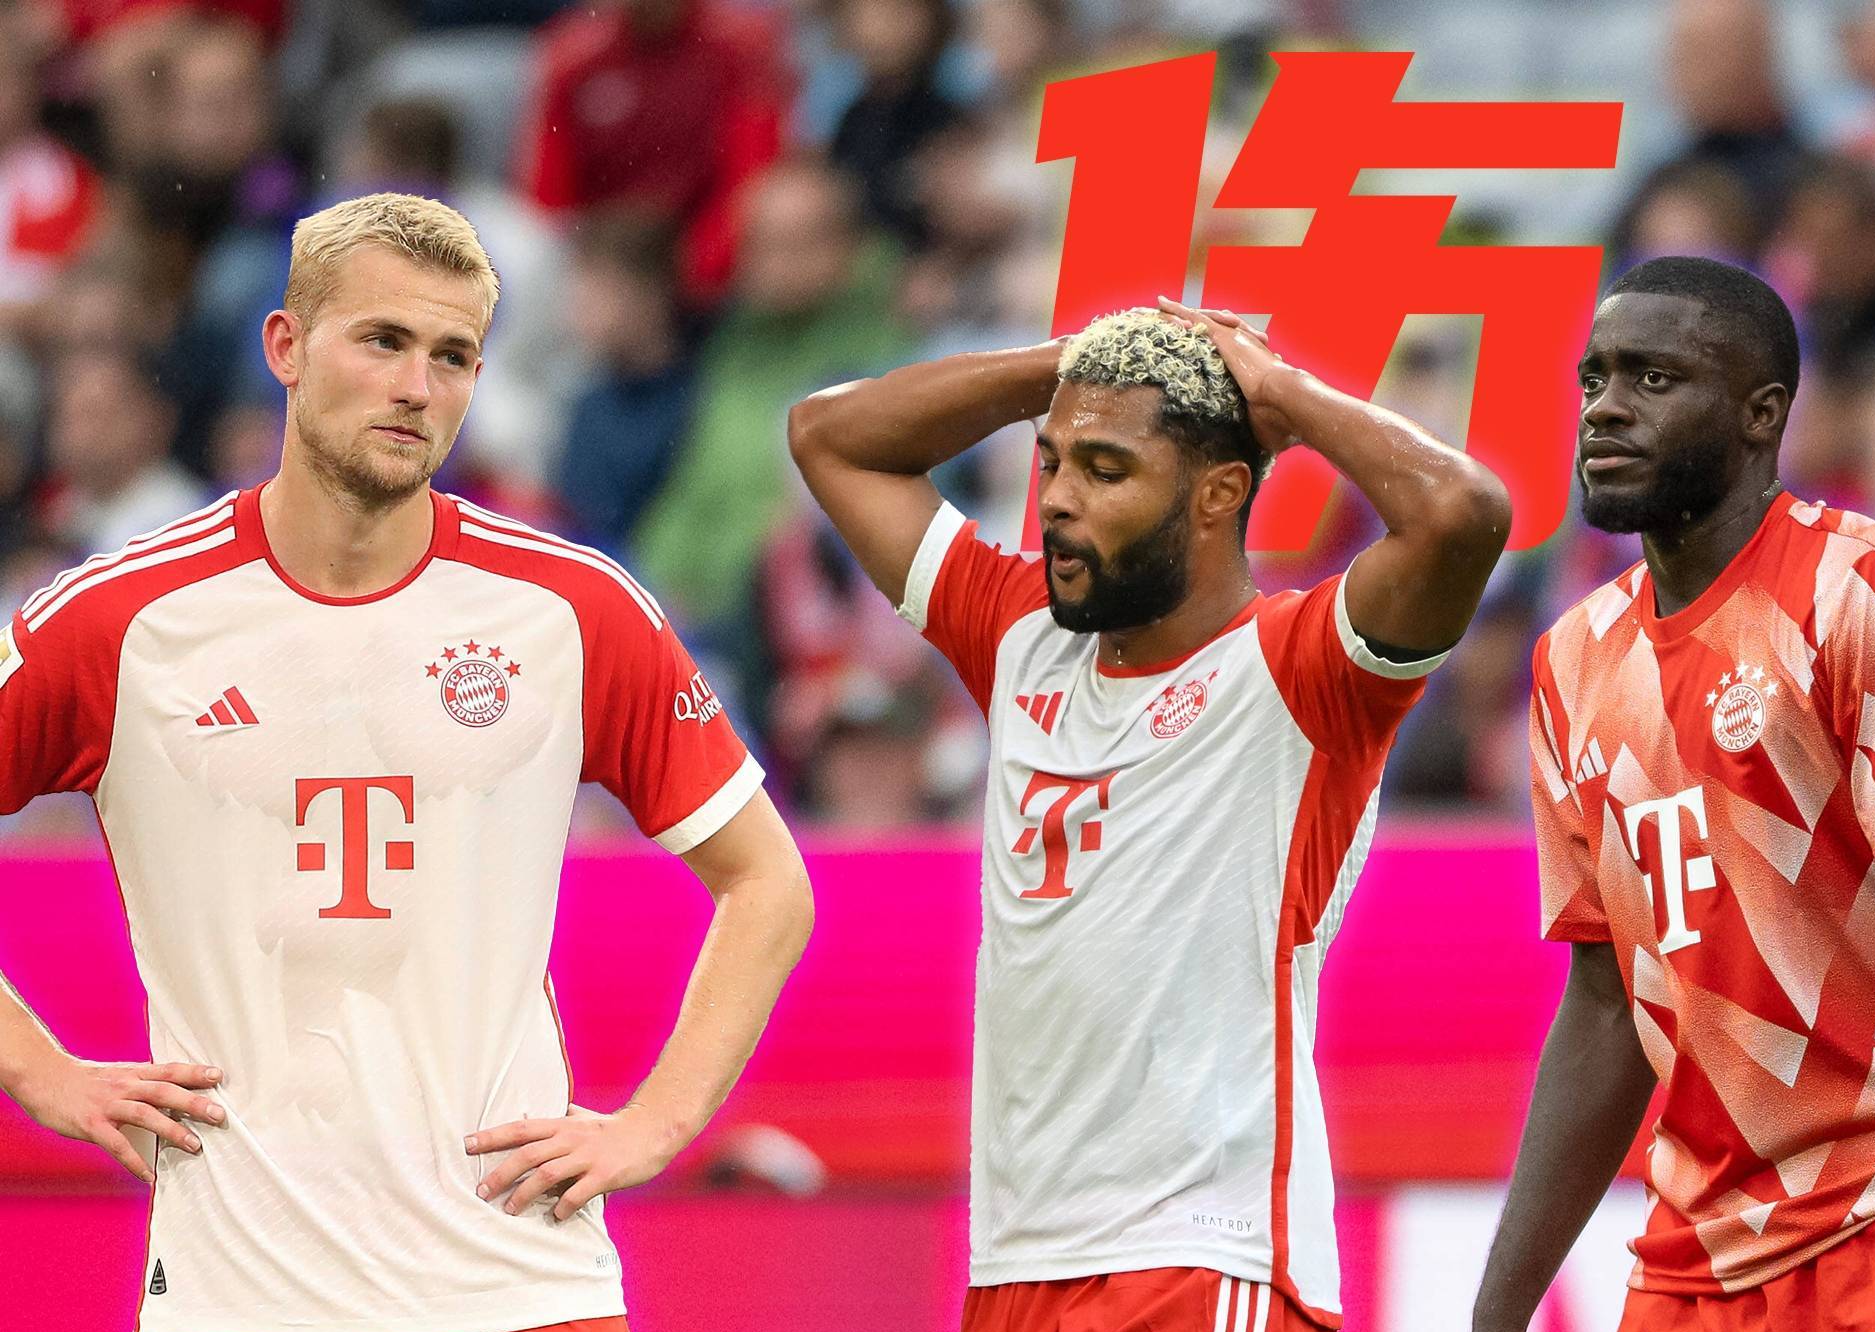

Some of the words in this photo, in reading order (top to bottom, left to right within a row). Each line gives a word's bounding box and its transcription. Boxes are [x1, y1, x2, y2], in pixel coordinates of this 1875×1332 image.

[447, 673, 460, 689] FC
[459, 664, 503, 688] BAYERN
[1728, 688, 1760, 712] BAYERN
[295, 775, 414, 918] T
[1019, 770, 1119, 899] T
[1623, 784, 1709, 956] T
